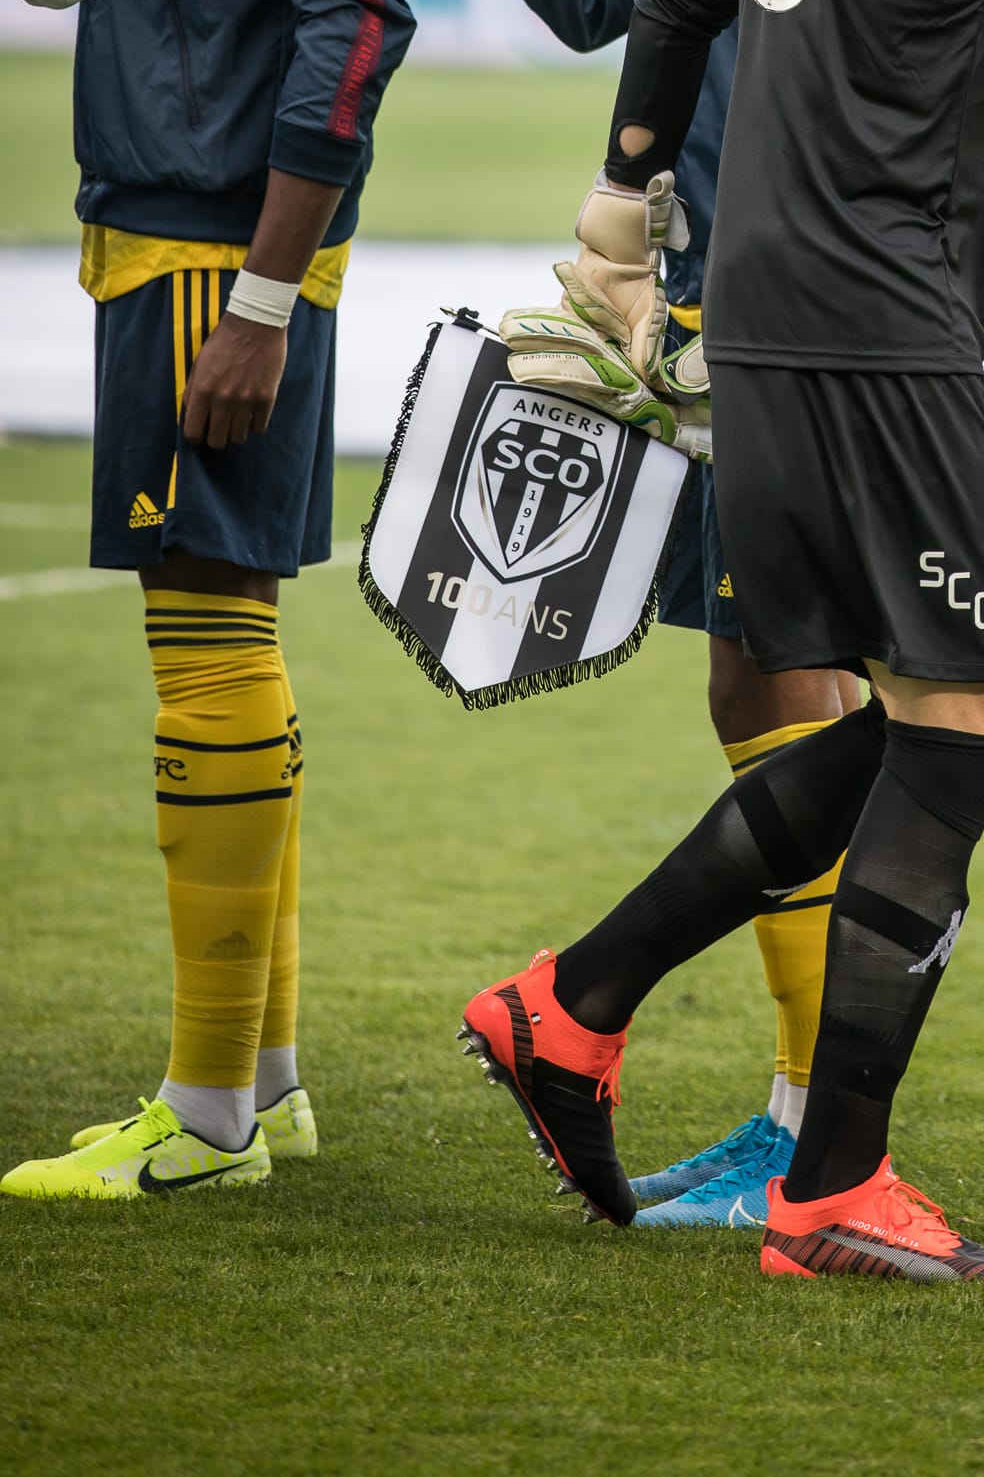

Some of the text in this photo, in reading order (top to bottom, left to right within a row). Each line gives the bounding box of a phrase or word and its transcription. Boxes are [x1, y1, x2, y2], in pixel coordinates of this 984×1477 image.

[513, 398, 606, 437] ANGERS
[493, 439, 590, 489] SCO
[511, 490, 536, 553] 1919
[427, 571, 573, 641] 100 ANS
[847, 1218, 871, 1231] LUDO
